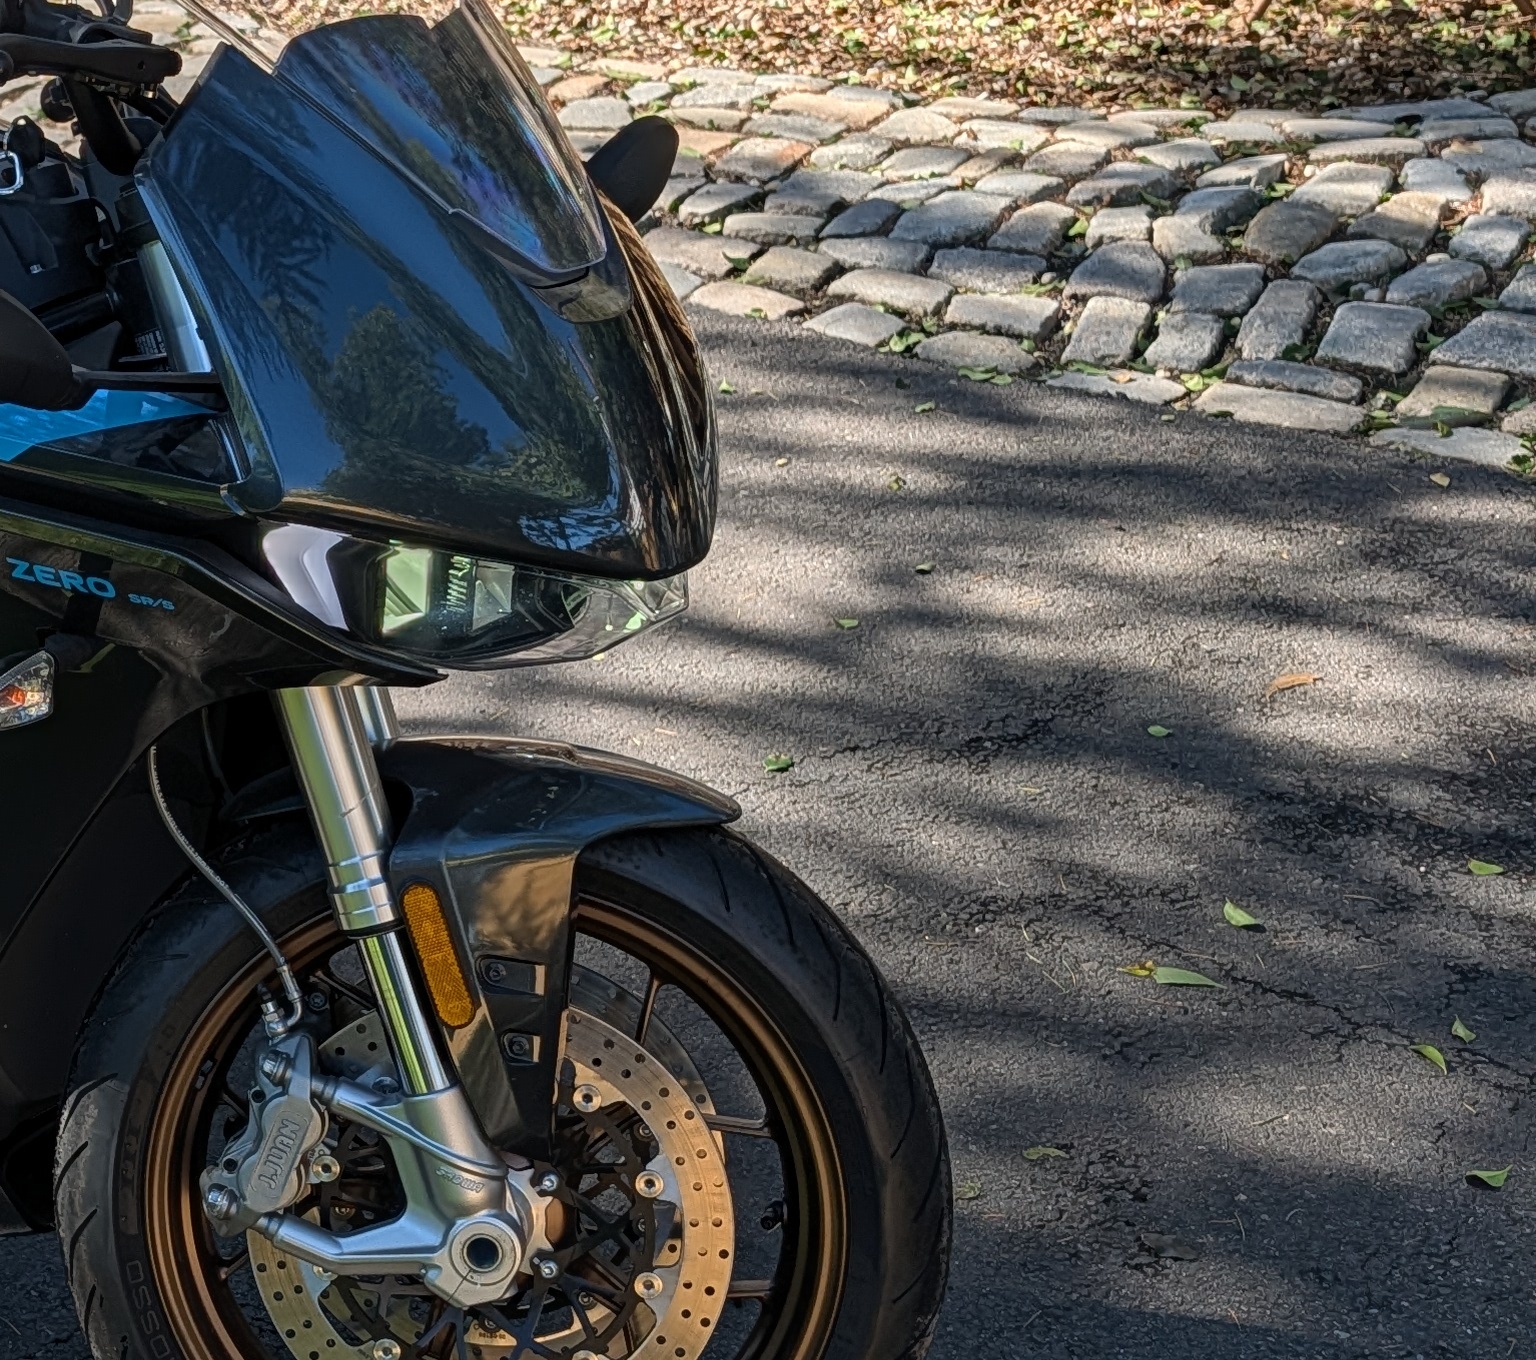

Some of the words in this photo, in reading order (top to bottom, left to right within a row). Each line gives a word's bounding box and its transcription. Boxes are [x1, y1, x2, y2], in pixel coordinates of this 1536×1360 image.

[6, 556, 116, 599] ZERO
[128, 593, 176, 611] SR/S
[258, 1118, 301, 1190] J.JUAN
[435, 1166, 485, 1193] SHOWA
